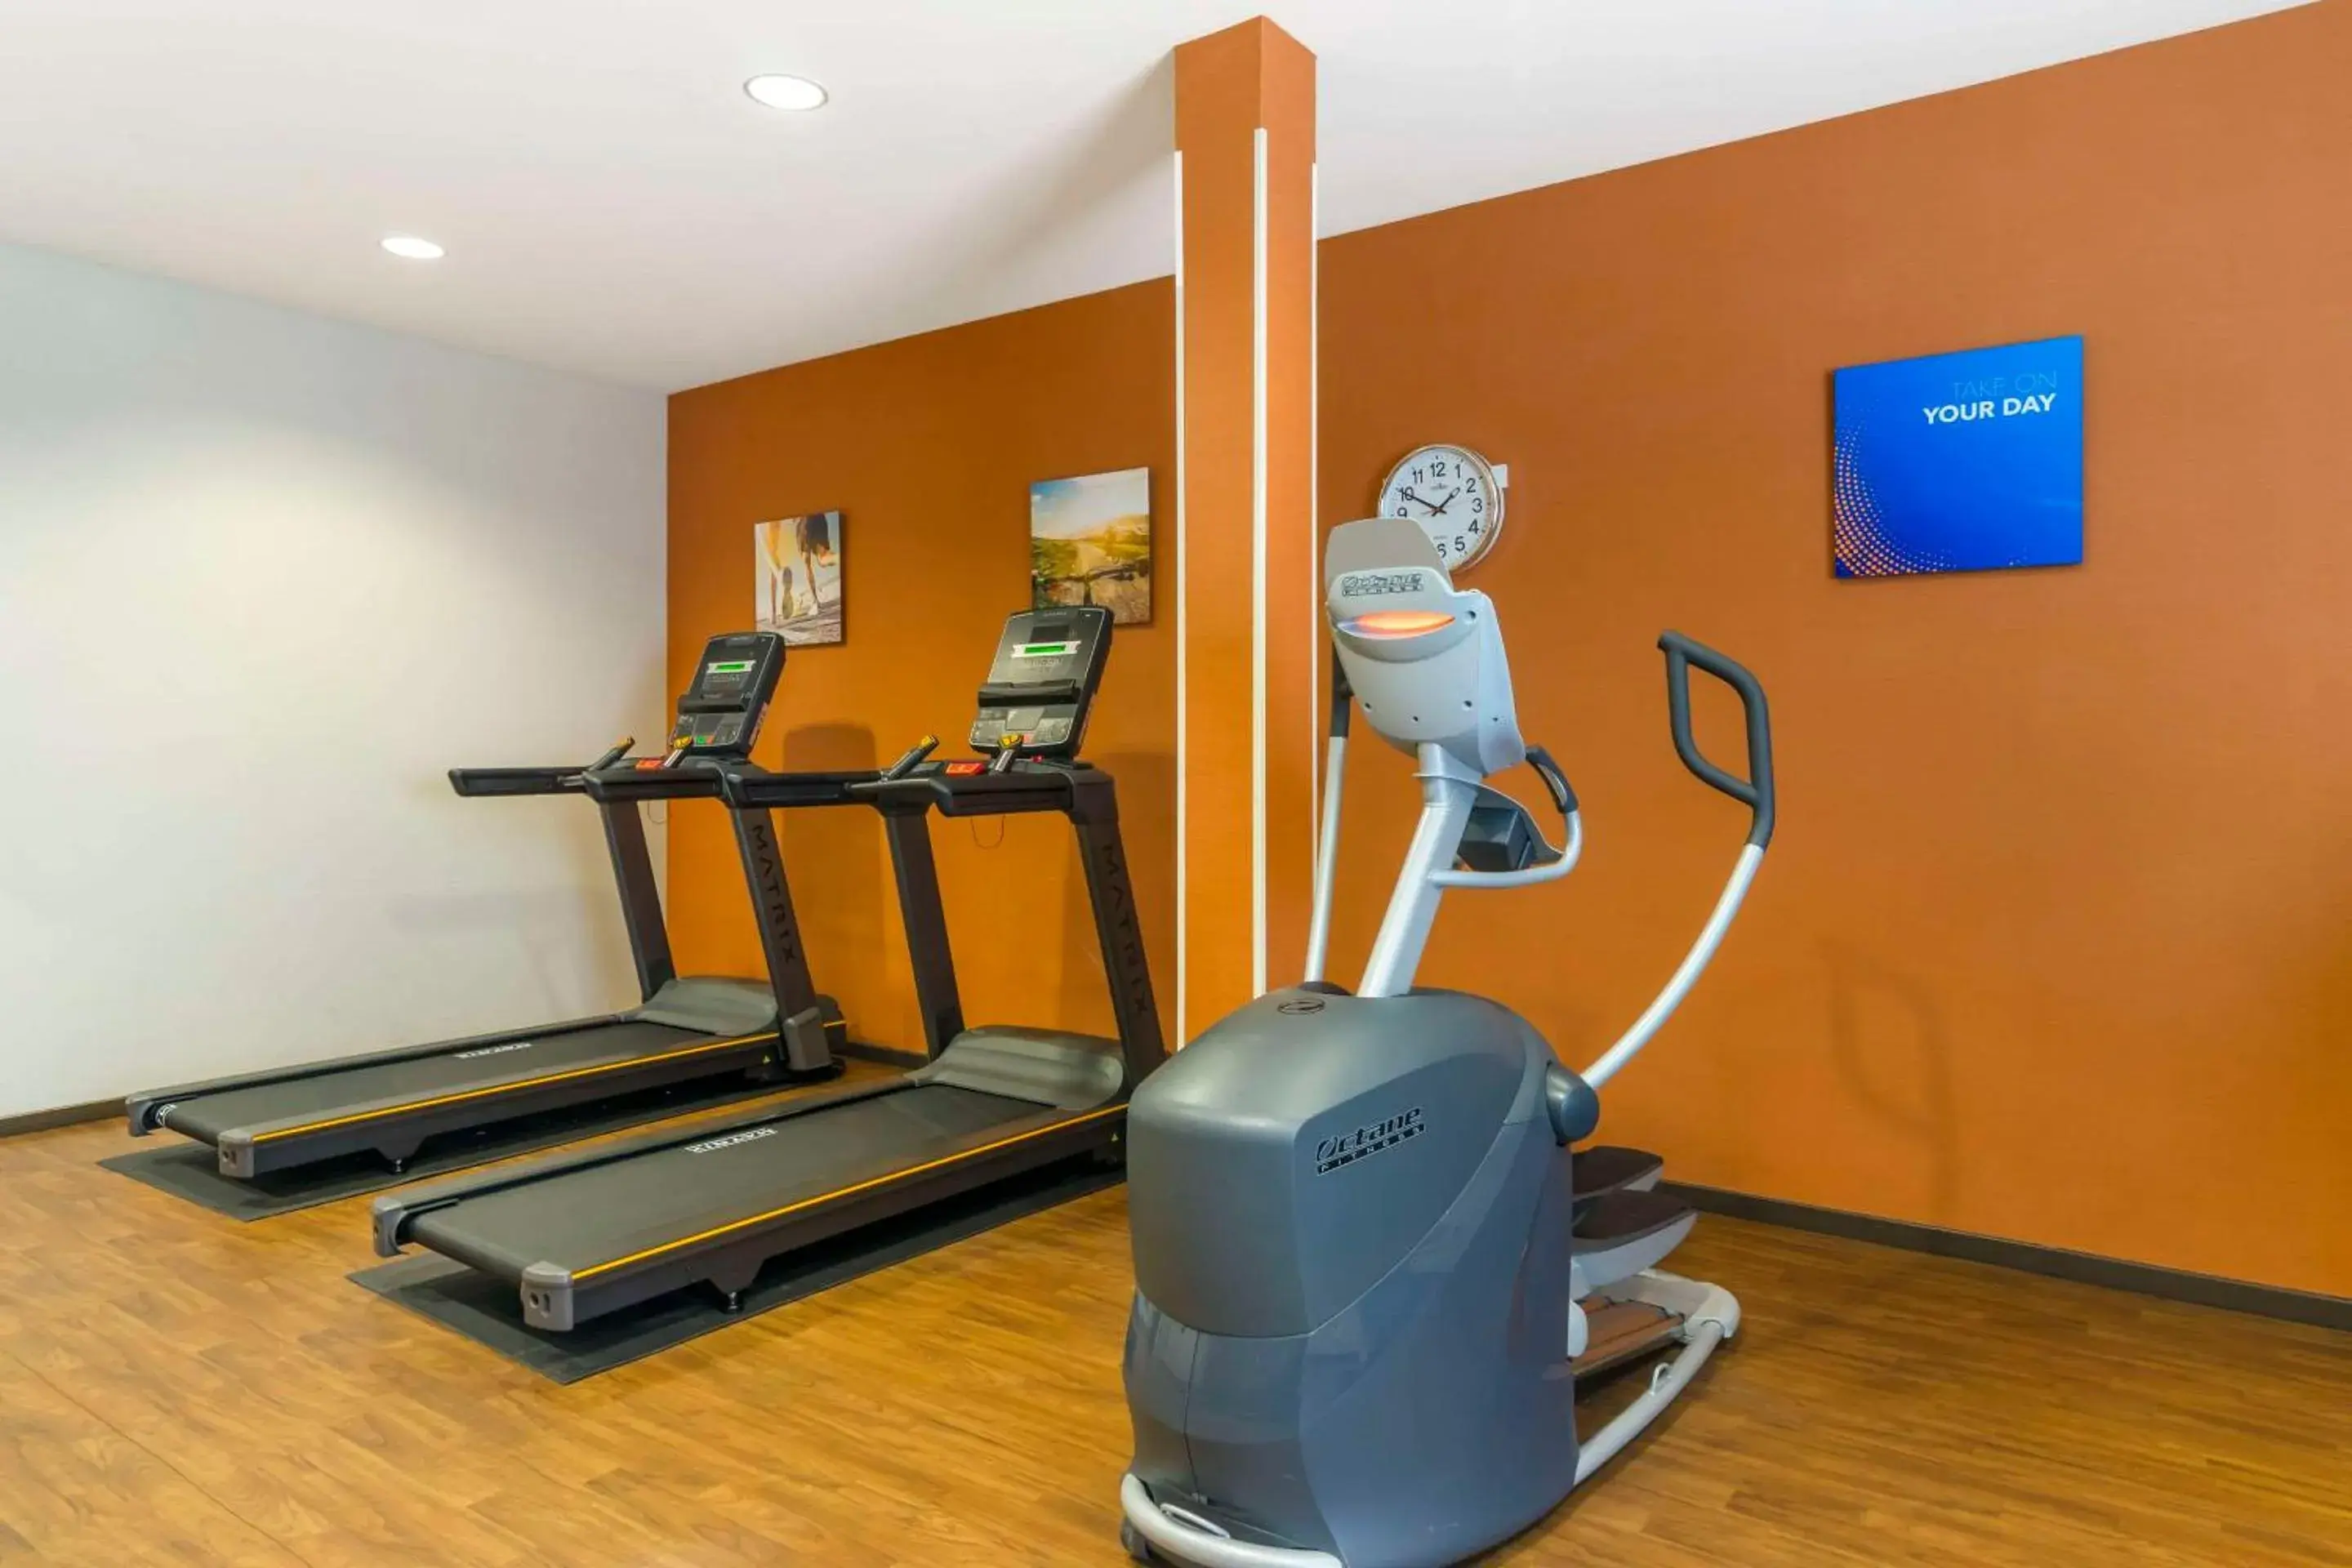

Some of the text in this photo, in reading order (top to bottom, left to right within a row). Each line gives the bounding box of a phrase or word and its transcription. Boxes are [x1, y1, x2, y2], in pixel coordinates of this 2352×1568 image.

[1922, 393, 2056, 425] YOUR DAY
[1413, 470, 1423, 483] 11
[1431, 462, 1446, 477] 12
[1454, 464, 1461, 479] 1
[1466, 478, 1477, 493] 2
[1472, 498, 1483, 513] 3
[1468, 519, 1480, 534] 4
[1454, 536, 1465, 551] 5
[752, 824, 796, 964] MATRIX
[1316, 1107, 1421, 1163] Octane
